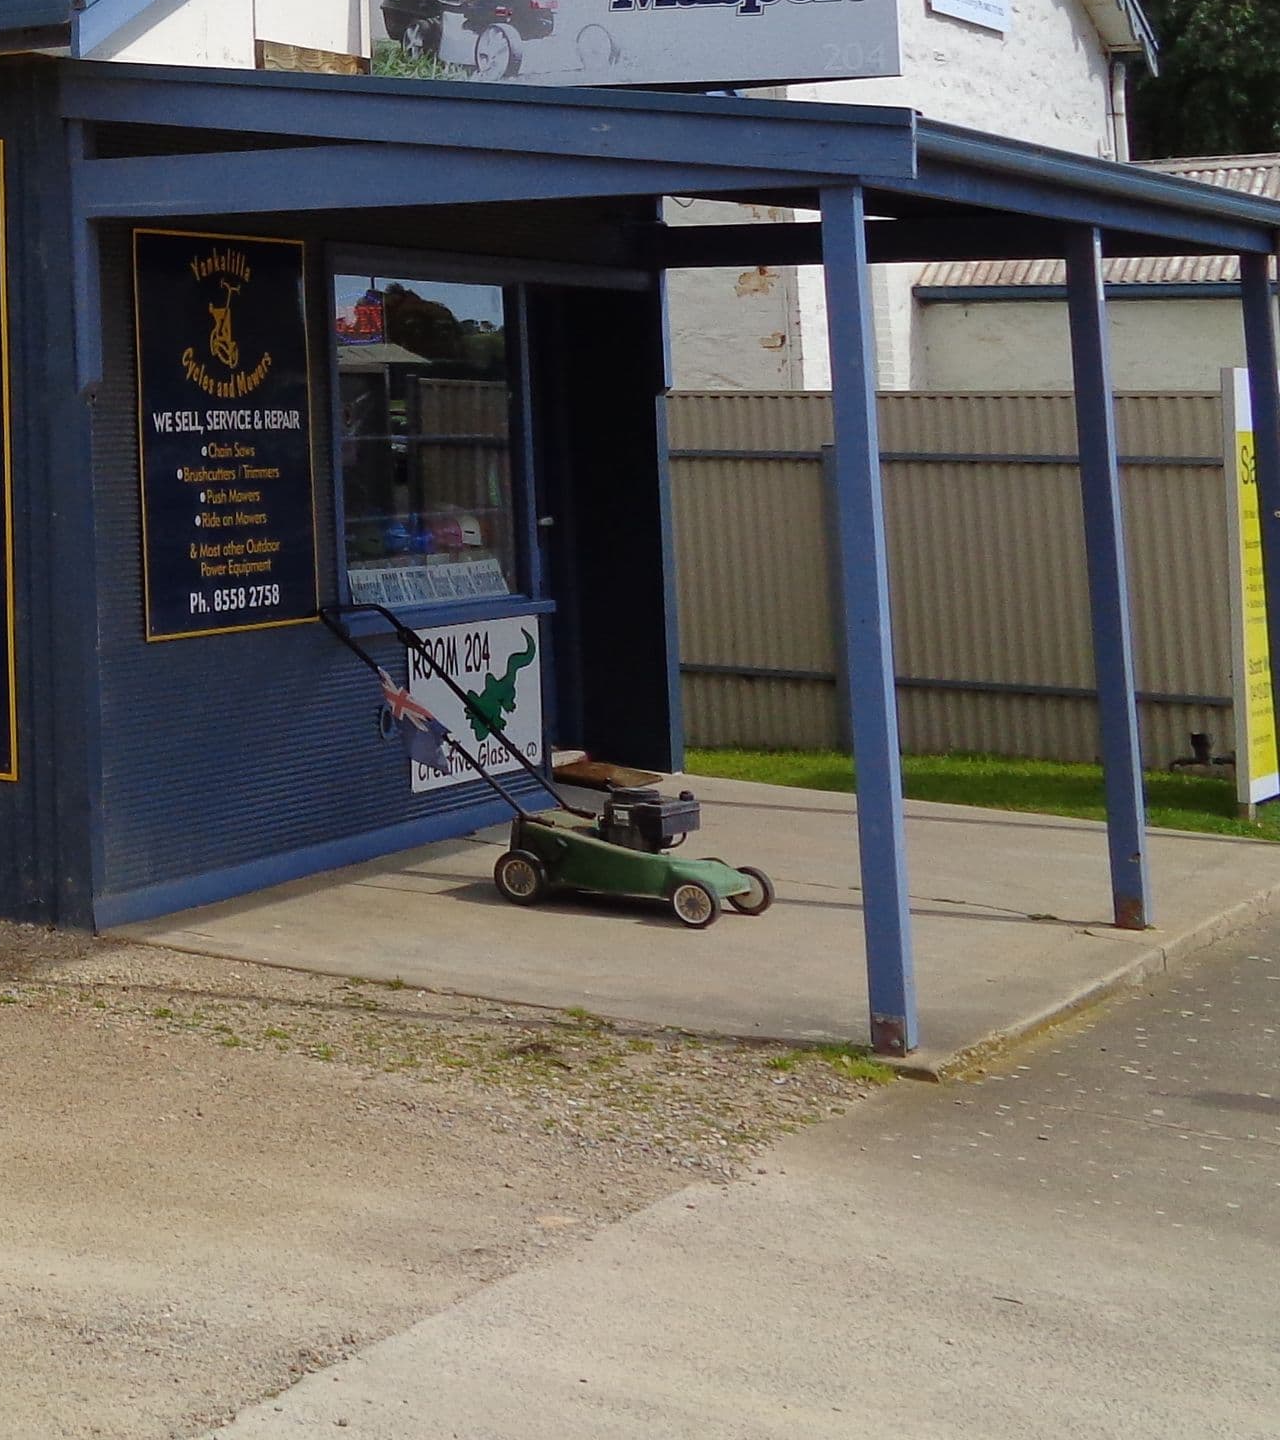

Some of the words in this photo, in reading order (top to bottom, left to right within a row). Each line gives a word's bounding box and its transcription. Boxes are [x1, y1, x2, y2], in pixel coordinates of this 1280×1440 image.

[190, 247, 252, 283] Yankalilla
[182, 347, 214, 394] Cycles
[217, 373, 235, 398] and
[237, 351, 272, 397] Mowers
[153, 412, 173, 433] WE
[174, 411, 204, 435] SELL,
[206, 410, 252, 431] SERVICE
[253, 410, 263, 429] &
[264, 410, 301, 430] REPAIR
[208, 442, 233, 458] Chain
[234, 442, 256, 458] Saws
[184, 466, 236, 482] Brushcutters
[242, 464, 280, 480] Trimmers
[206, 489, 227, 505] Push
[229, 488, 261, 503] Mowers
[201, 512, 221, 529] Ride
[222, 516, 234, 527] on
[235, 512, 268, 527] Mowers
[190, 542, 198, 559] &
[200, 543, 221, 558] Most
[223, 540, 245, 556] other
[246, 538, 281, 554] Outdoor
[201, 561, 226, 577] Power
[228, 558, 272, 577] Equipment
[190, 591, 210, 614] Ph.
[214, 586, 246, 612] 8558
[249, 583, 280, 608] 2758
[412, 634, 459, 681] ROOM
[464, 631, 491, 673] 204
[478, 740, 511, 768] Glass
